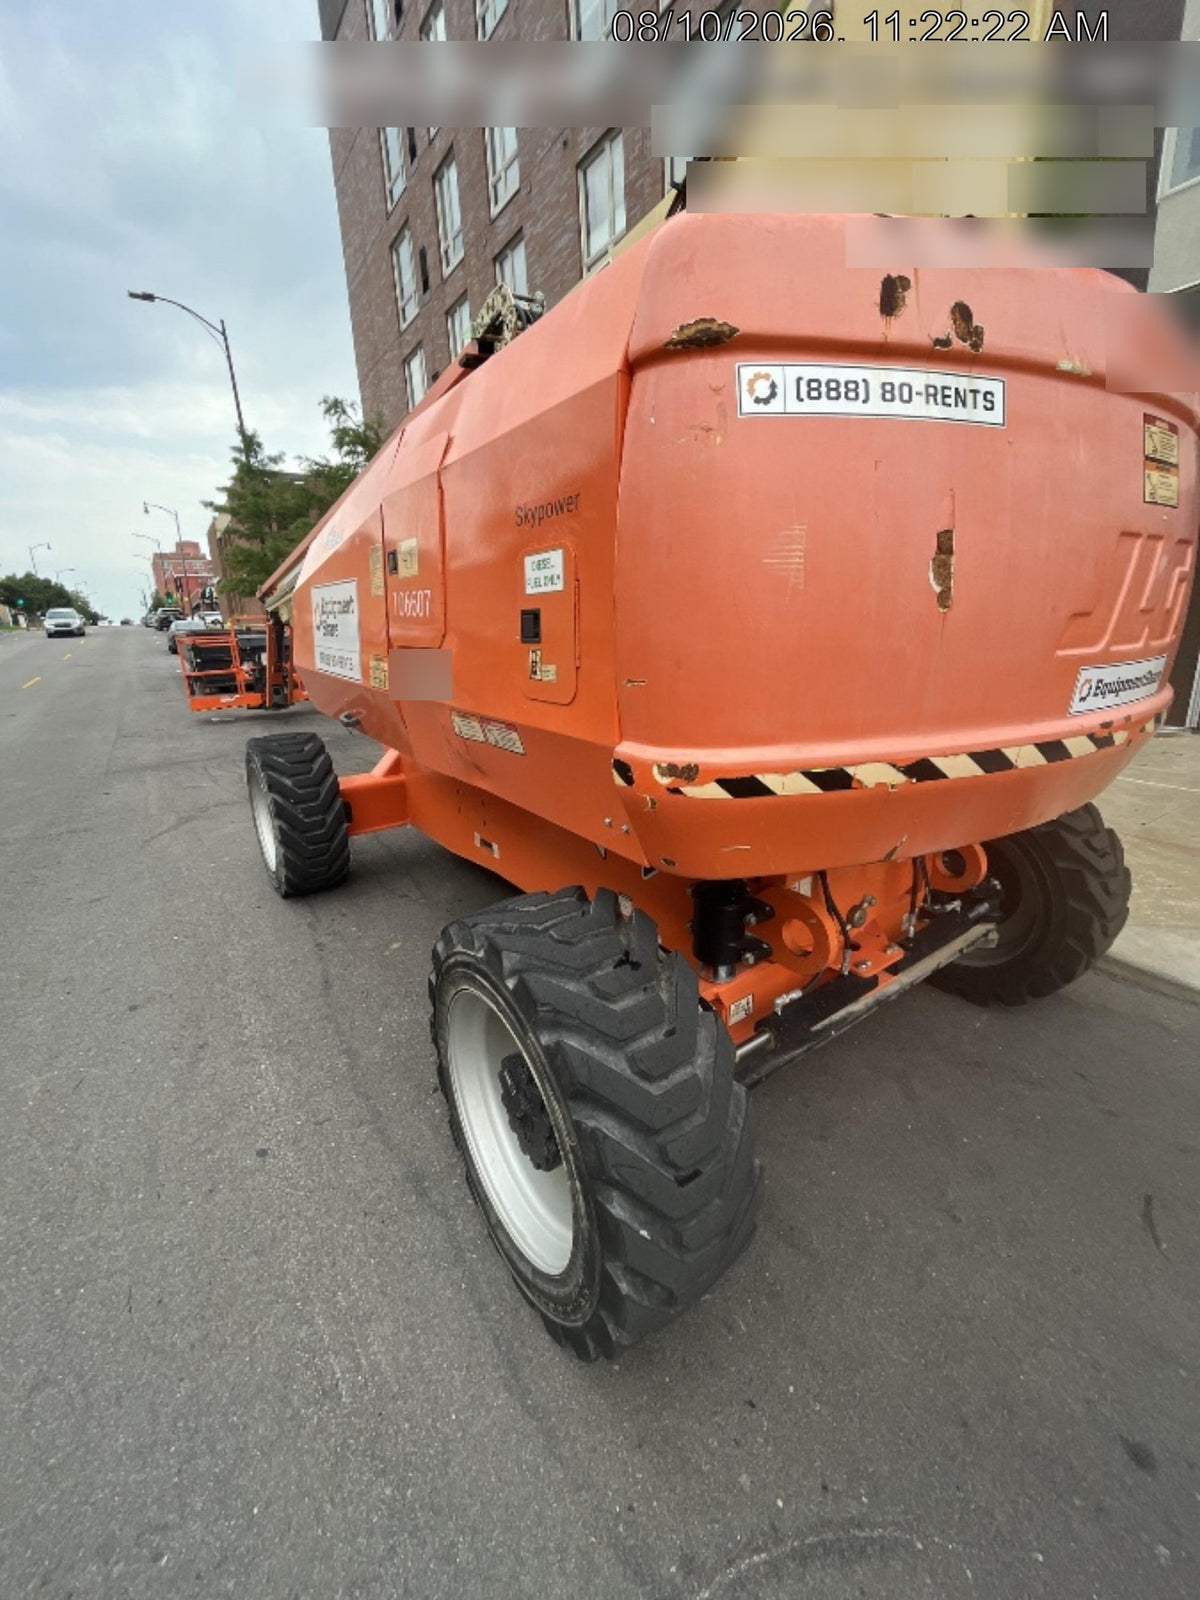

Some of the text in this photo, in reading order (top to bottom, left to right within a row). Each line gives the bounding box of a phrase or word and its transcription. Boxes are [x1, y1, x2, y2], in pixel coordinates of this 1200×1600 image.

[795, 376, 996, 411] (888) 80-RENTS
[514, 492, 580, 528] Skypower
